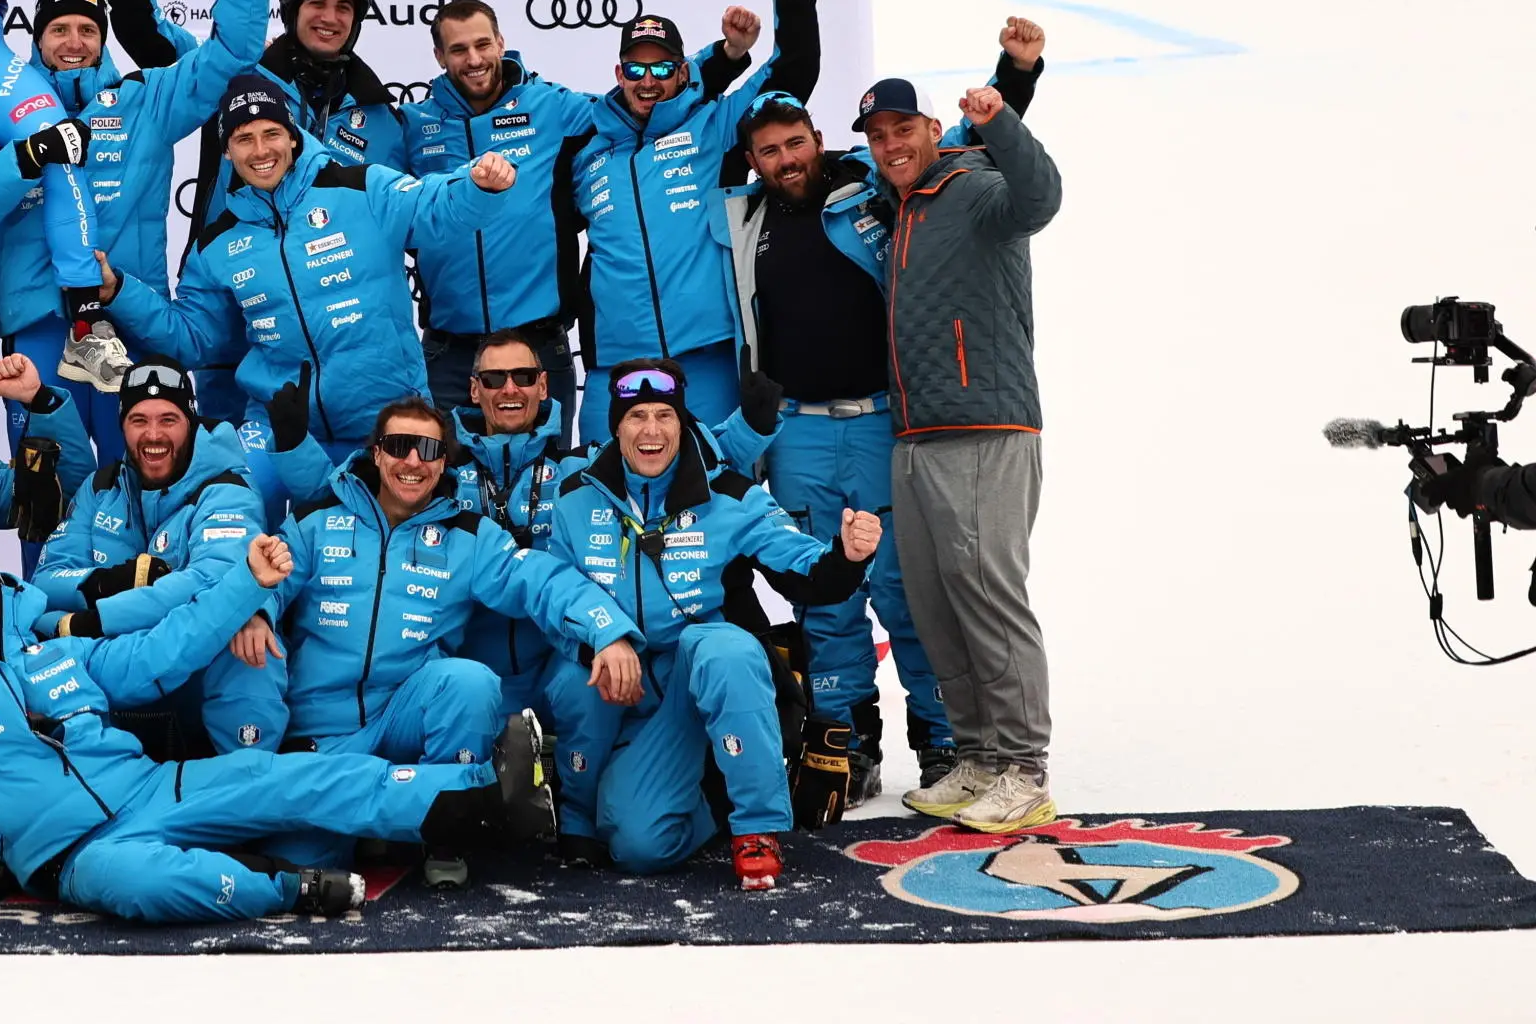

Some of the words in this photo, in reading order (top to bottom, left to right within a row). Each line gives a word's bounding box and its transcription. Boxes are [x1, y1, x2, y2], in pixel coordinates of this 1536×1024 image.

[631, 29, 647, 39] Red
[648, 28, 666, 39] Bull
[14, 96, 54, 120] enel
[91, 118, 121, 129] POLIZIA
[495, 115, 528, 127] DOCTOR
[338, 129, 366, 147] DOCTOR
[490, 128, 536, 142] FALCONERI
[95, 151, 122, 163] enel
[654, 147, 699, 163] FALCONERI
[664, 164, 693, 179] enel
[229, 235, 253, 253] EA7
[306, 249, 353, 270] FALCONERI
[320, 267, 352, 287] enel
[95, 511, 124, 531] EA7
[326, 516, 356, 528] EA7
[591, 509, 614, 521] EA7
[402, 562, 450, 580] FALCONERI
[668, 568, 700, 582] enel
[406, 583, 438, 600] enel
[320, 602, 350, 615] FORST
[30, 657, 76, 685] FALCONERI
[48, 678, 80, 701] enel
[812, 676, 839, 690] EA7
[811, 756, 842, 767] LEVEL
[216, 873, 235, 905] EA7
